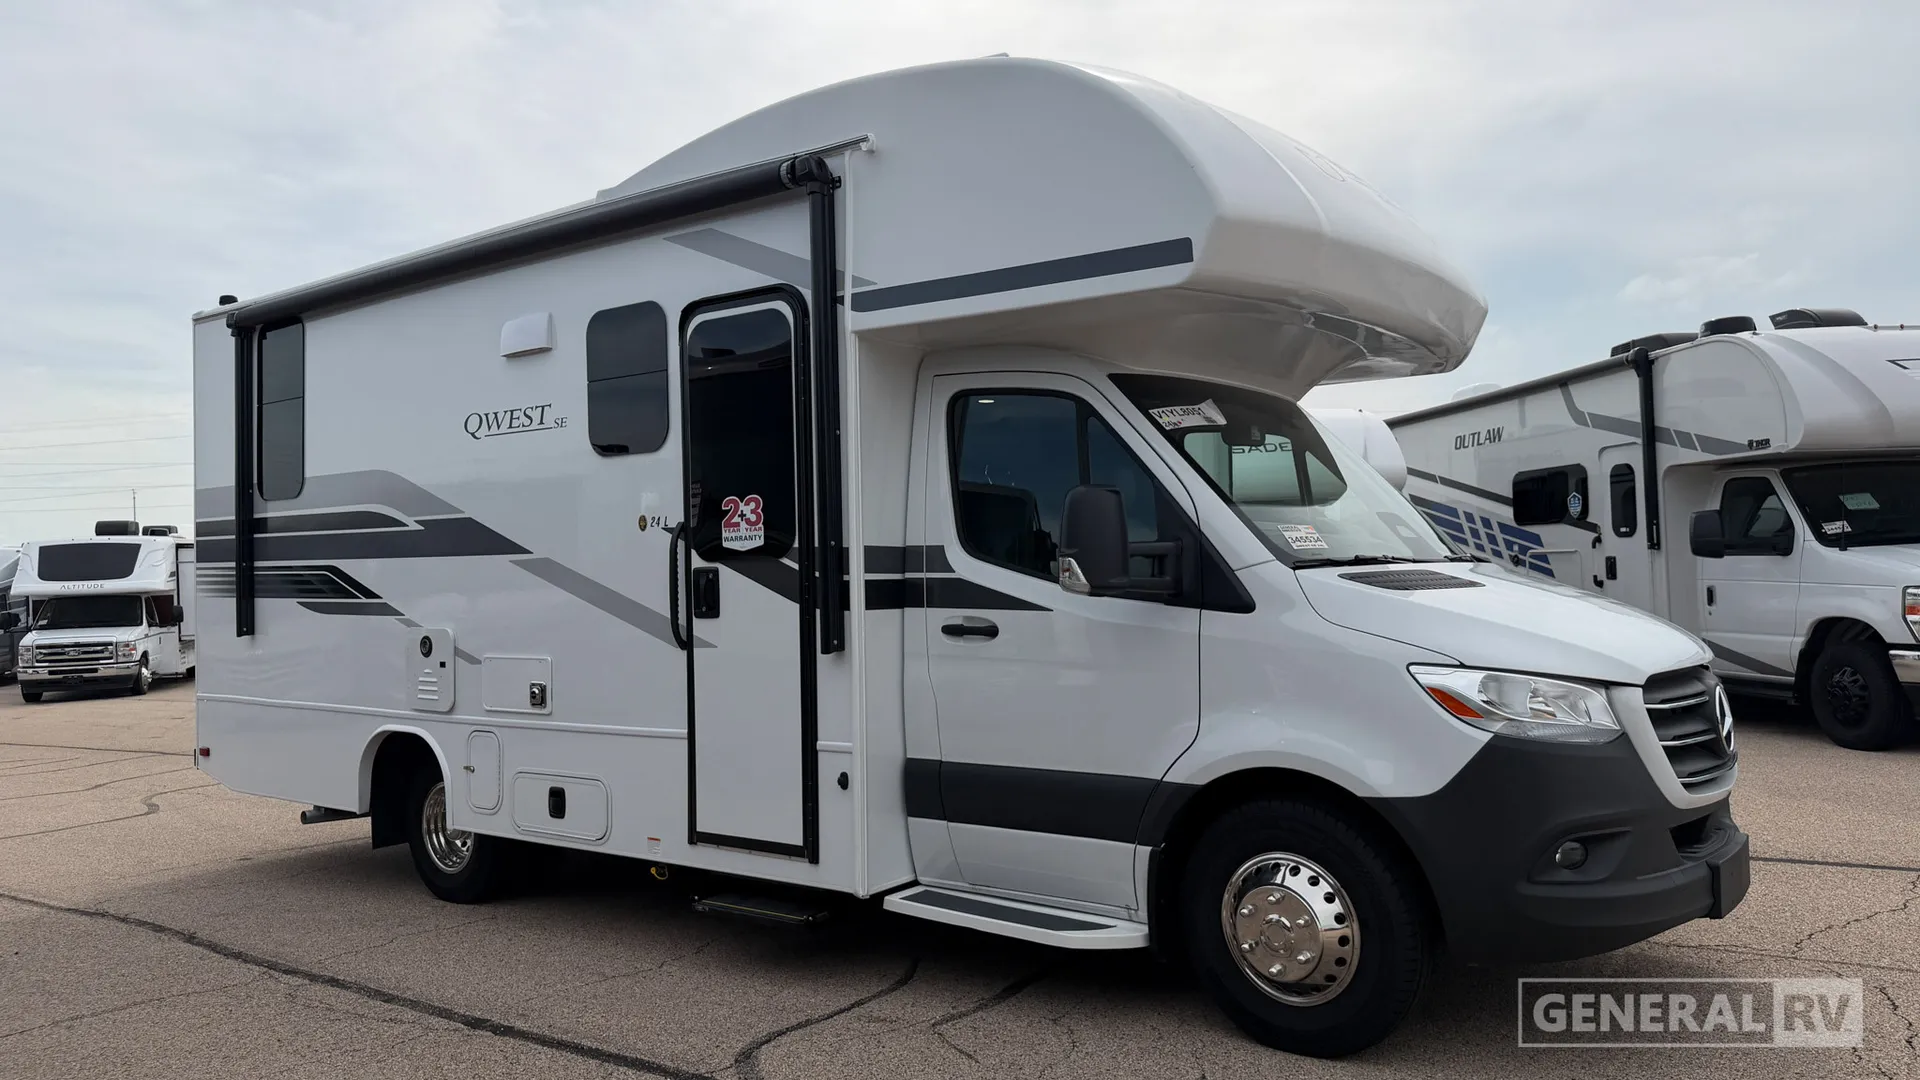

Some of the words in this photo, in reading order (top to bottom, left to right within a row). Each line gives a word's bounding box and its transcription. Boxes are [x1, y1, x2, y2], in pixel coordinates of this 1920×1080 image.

[1152, 407, 1206, 419] V1YL8051
[463, 403, 552, 440] QWEST
[553, 417, 568, 429] SE
[1454, 425, 1504, 450] OUTLAW
[1754, 438, 1771, 448] THOR
[650, 515, 661, 528] 24
[664, 515, 669, 527] L
[723, 534, 763, 543] WARRANTY
[1288, 535, 1323, 544] 345534
